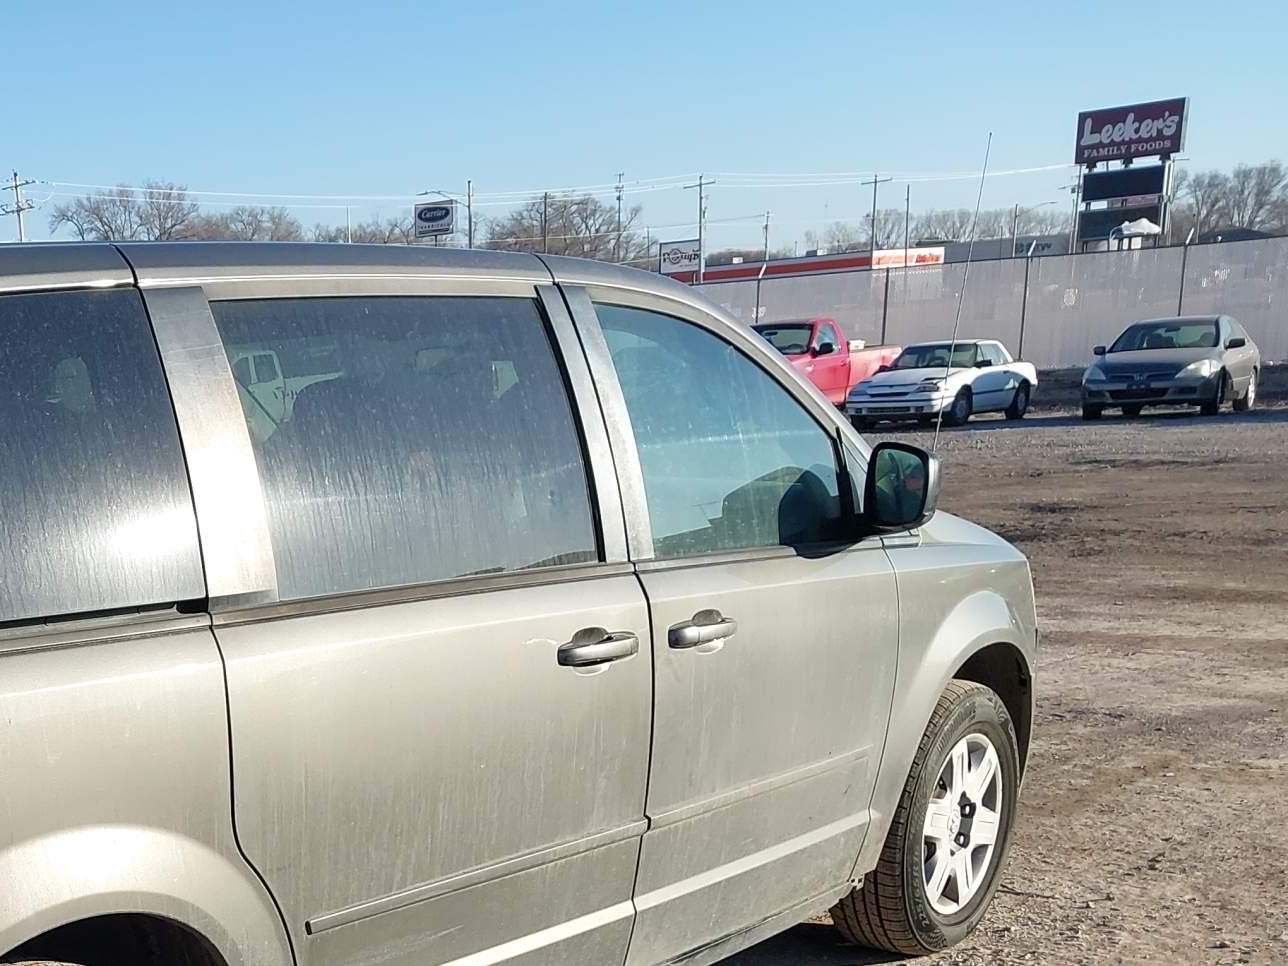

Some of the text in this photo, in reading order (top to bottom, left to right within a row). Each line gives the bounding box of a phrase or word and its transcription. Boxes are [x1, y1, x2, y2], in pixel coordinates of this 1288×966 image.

[1080, 111, 1179, 146] Leeker's
[1083, 140, 1171, 158] FAMILY FOODS
